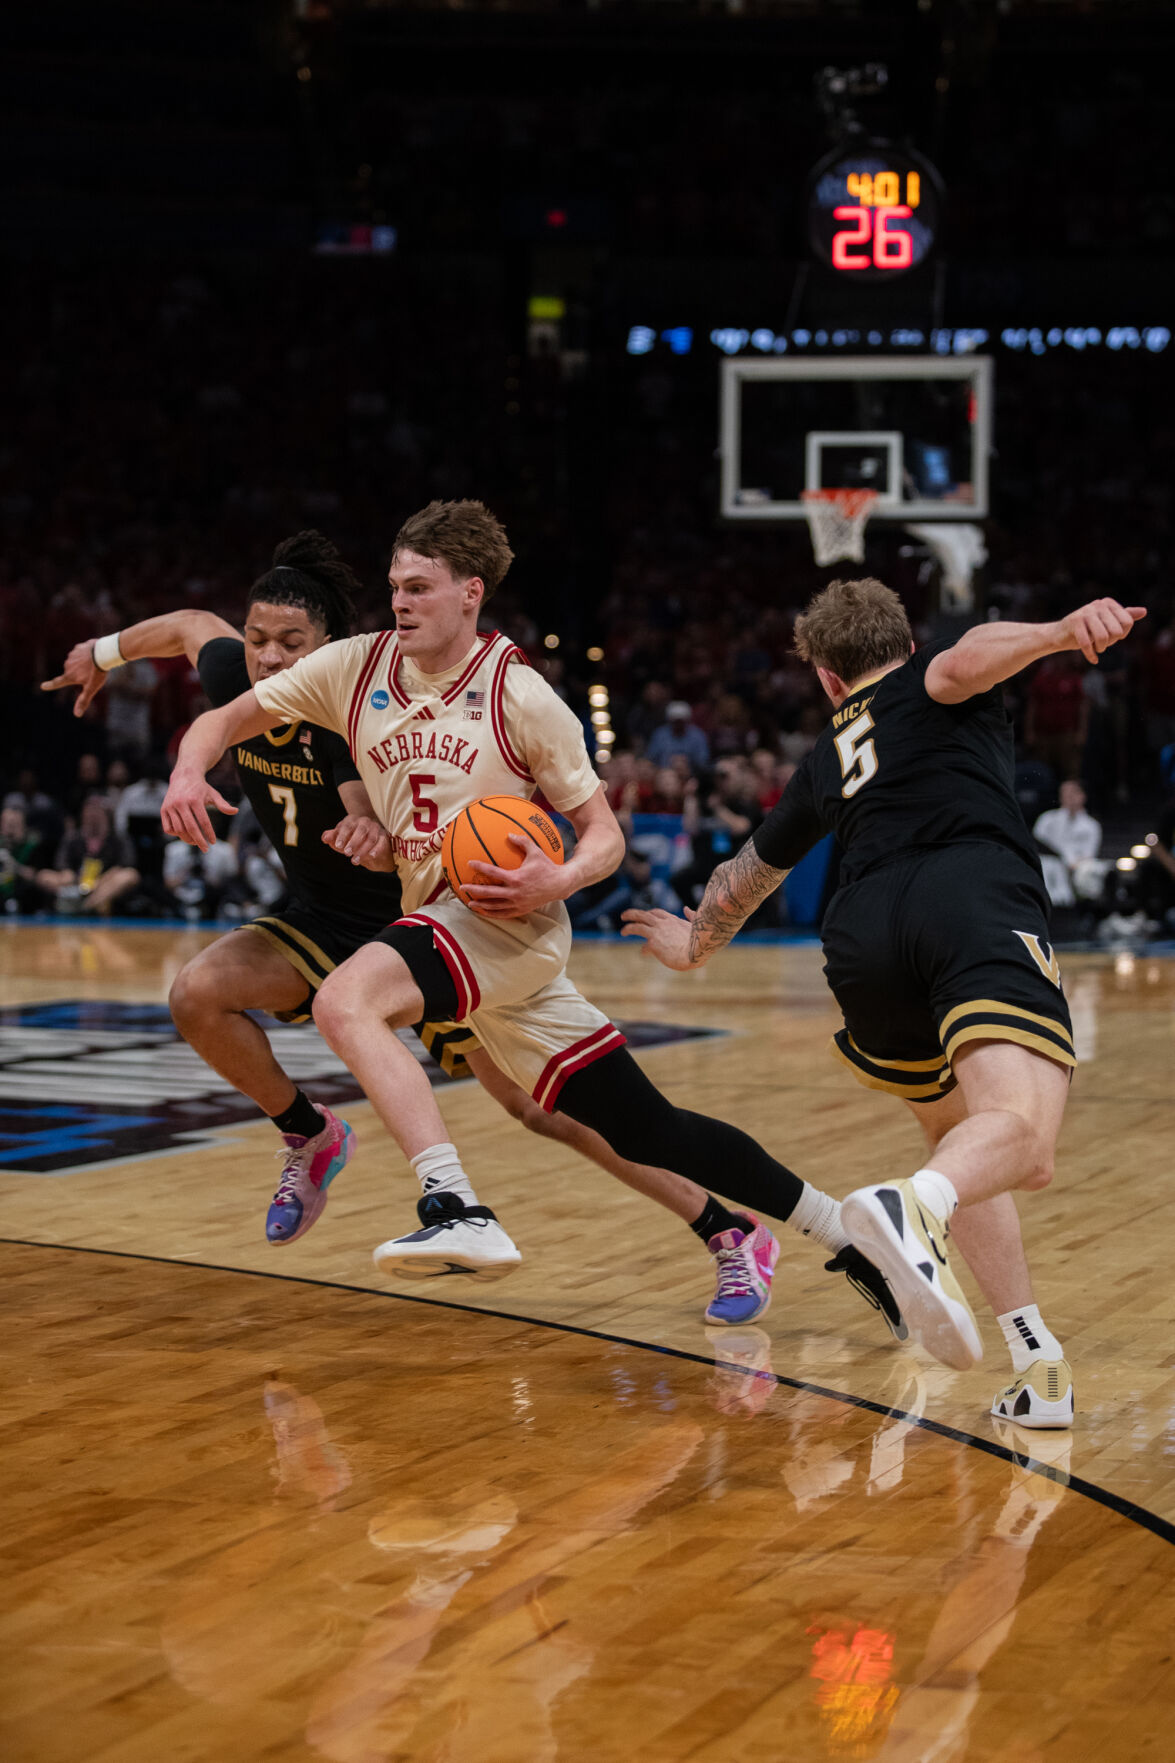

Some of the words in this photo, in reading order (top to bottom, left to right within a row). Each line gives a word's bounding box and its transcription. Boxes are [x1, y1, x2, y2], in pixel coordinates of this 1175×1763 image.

[832, 205, 913, 270] 26
[237, 747, 324, 786] VANDERBILT
[367, 731, 479, 775] NEBRASKA
[833, 708, 879, 799] 5
[267, 783, 299, 847] 7
[408, 774, 438, 833] 5
[1011, 930, 1061, 990] V
